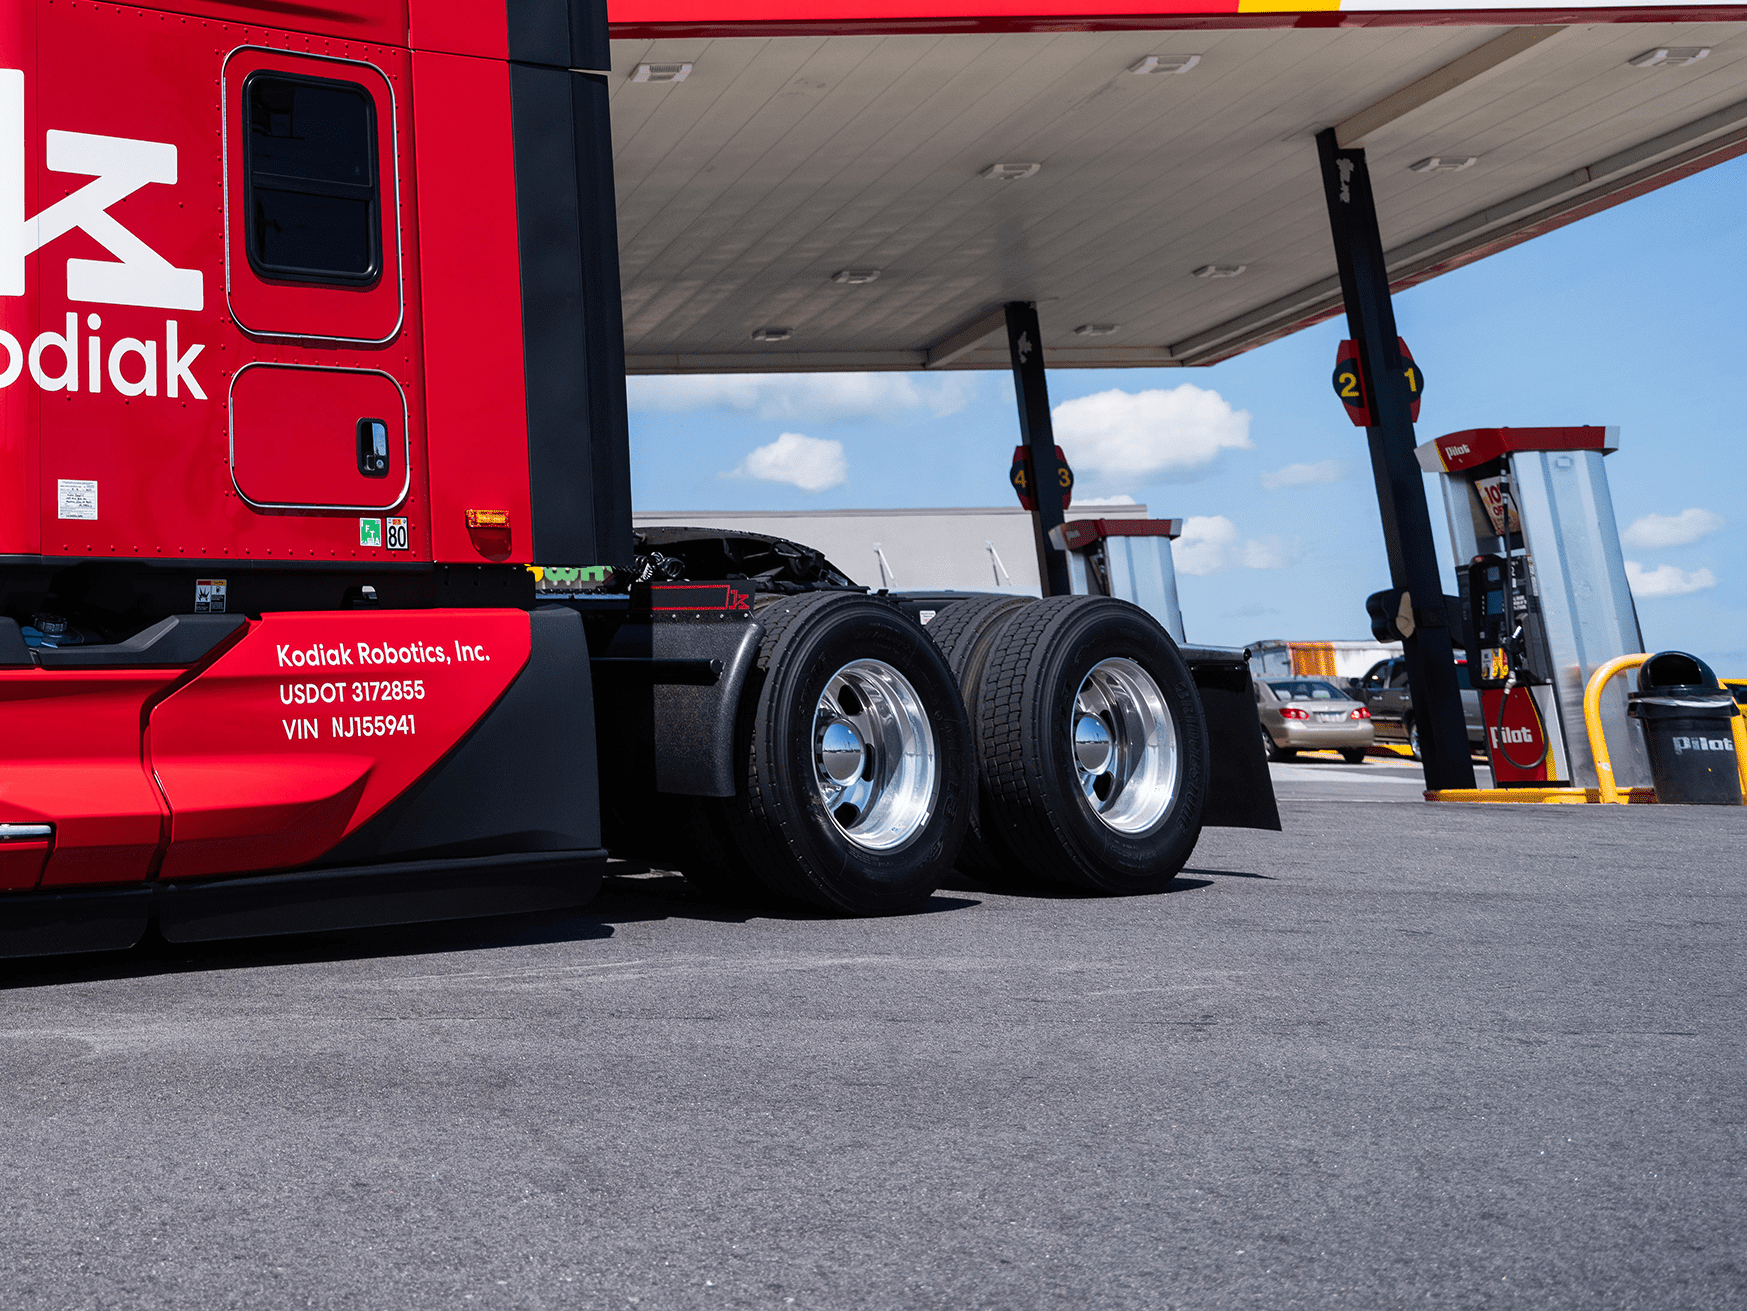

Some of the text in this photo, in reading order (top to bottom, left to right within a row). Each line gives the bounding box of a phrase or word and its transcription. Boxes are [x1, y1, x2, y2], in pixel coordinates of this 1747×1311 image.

[1339, 372, 1360, 397] 2
[1404, 368, 1417, 392] 1
[1445, 444, 1470, 460] Pilot
[1014, 469, 1027, 488] 4
[1058, 468, 1071, 487] 3
[1484, 482, 1501, 504] 10
[388, 525, 407, 548] 80
[277, 639, 491, 667] Kodiak Robotics, Inc.
[279, 679, 426, 705] USDOT 3172855
[282, 714, 416, 740] VIN NJ155941
[1489, 726, 1533, 749] Pilot
[1672, 736, 1734, 755] Pilot
